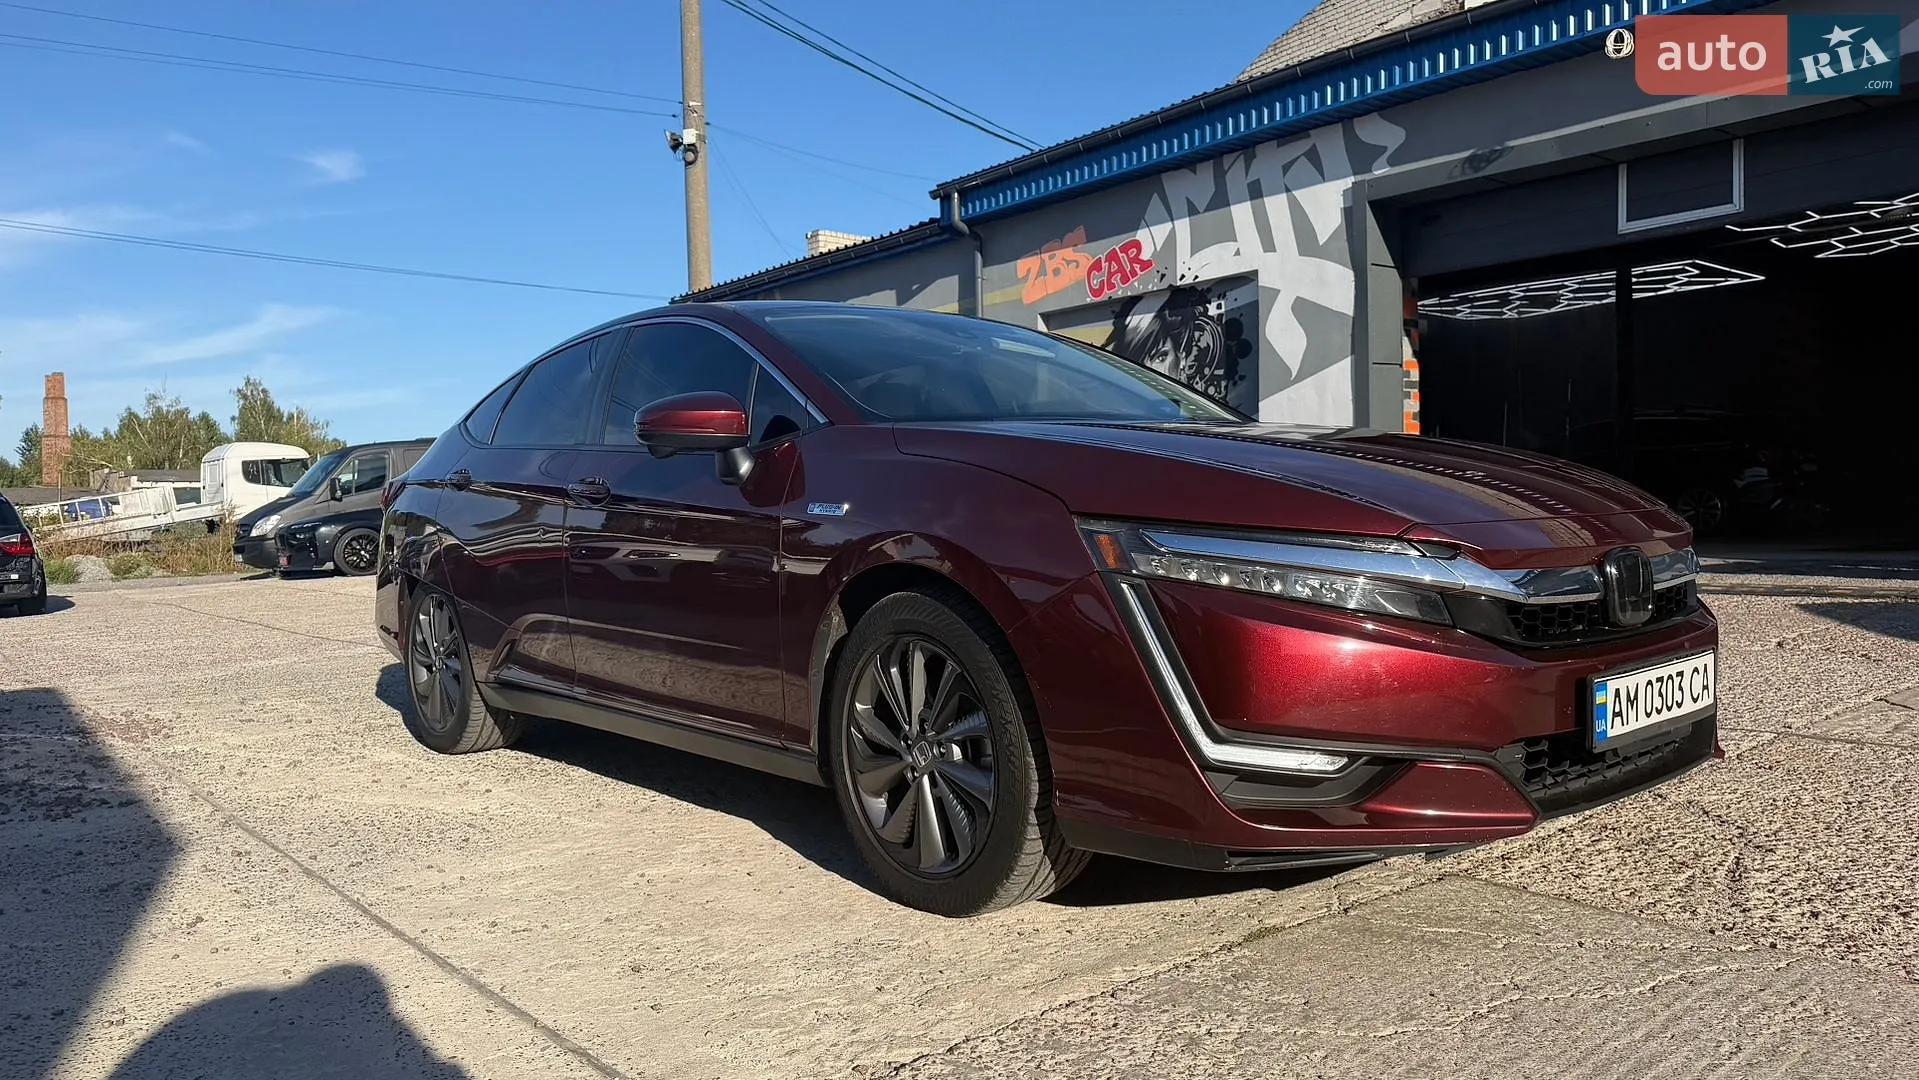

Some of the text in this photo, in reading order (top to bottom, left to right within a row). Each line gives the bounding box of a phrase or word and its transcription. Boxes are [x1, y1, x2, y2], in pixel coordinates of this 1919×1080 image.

[1085, 237, 1155, 301] CAR
[1595, 719, 1607, 732] UA
[1610, 663, 1710, 729] AM 0303 CA
